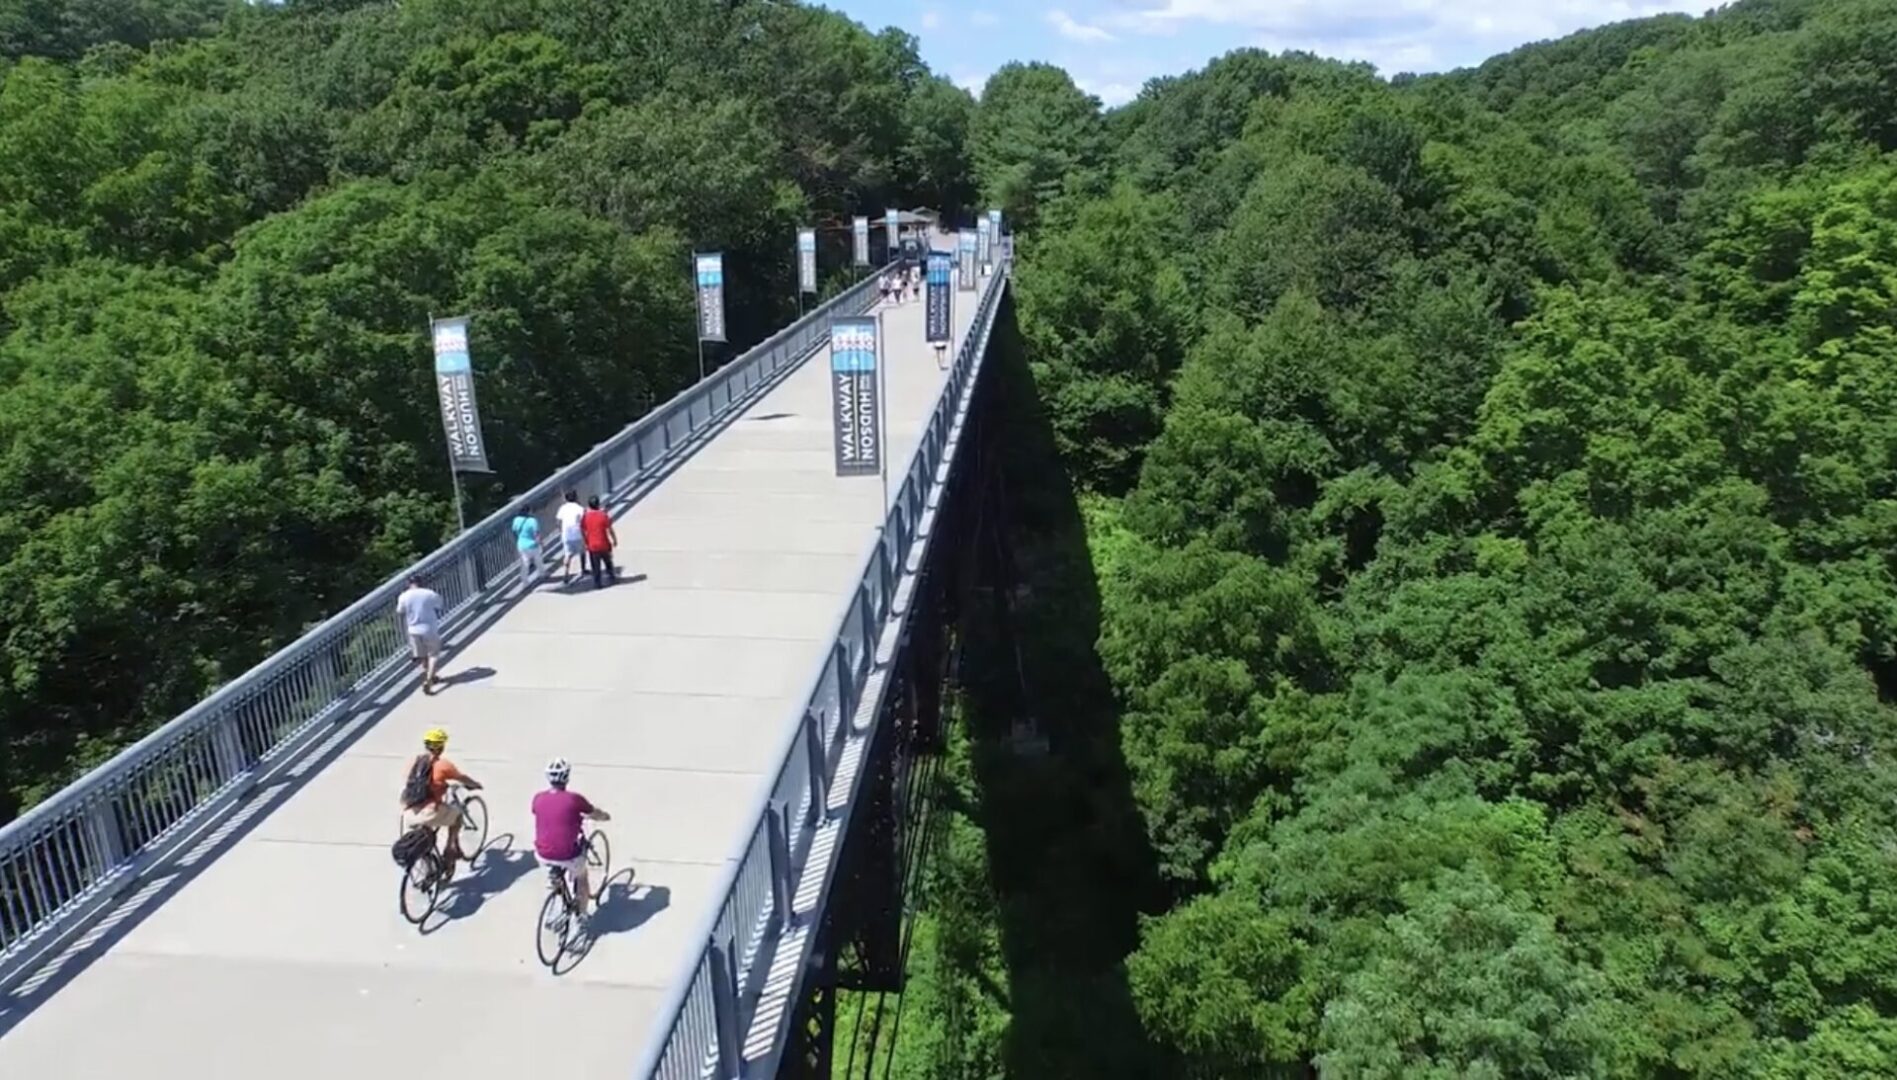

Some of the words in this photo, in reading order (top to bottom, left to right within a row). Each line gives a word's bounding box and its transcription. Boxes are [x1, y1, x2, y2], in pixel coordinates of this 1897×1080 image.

[440, 374, 464, 456] WALKWAY
[458, 391, 480, 456] HUDSON
[839, 374, 854, 460] WALKWAY
[859, 392, 873, 460] HUDSON
